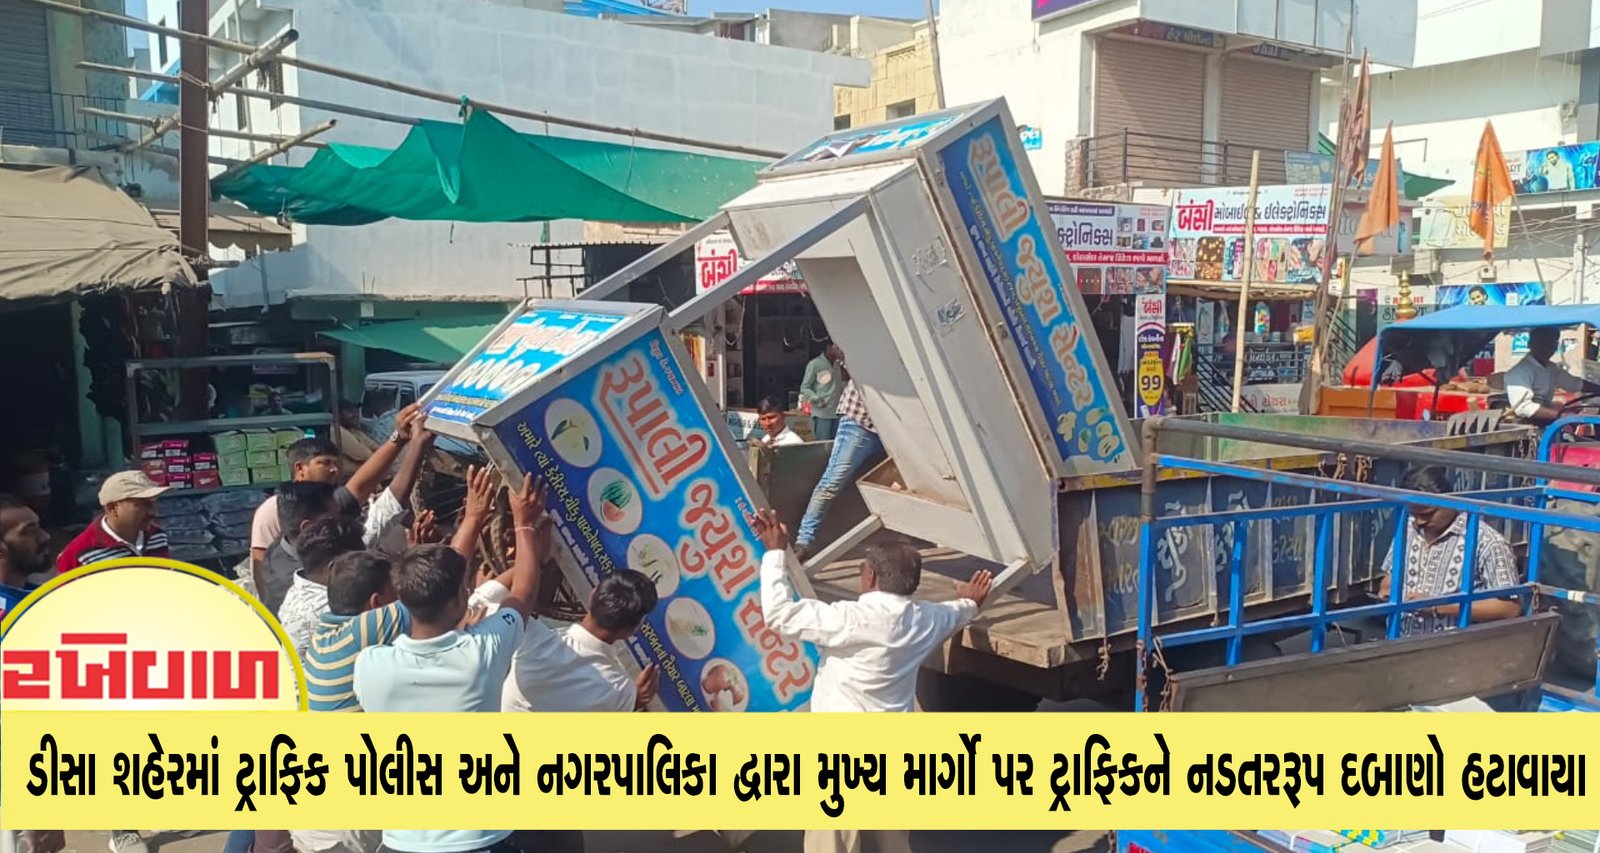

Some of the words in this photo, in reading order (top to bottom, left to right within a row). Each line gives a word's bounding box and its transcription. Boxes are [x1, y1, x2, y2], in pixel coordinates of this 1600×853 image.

[969, 135, 1027, 239] રૂપાલી
[1175, 199, 1214, 231] બંસી
[1057, 220, 1113, 248] ક્ટ્રોનિક્સ
[697, 248, 738, 289] બંસી
[1141, 374, 1162, 391] 99
[518, 421, 542, 450] અમારે
[598, 357, 711, 494] રૂપાલી
[680, 483, 755, 595] જ્યુશ
[738, 597, 811, 698] સન્ટર
